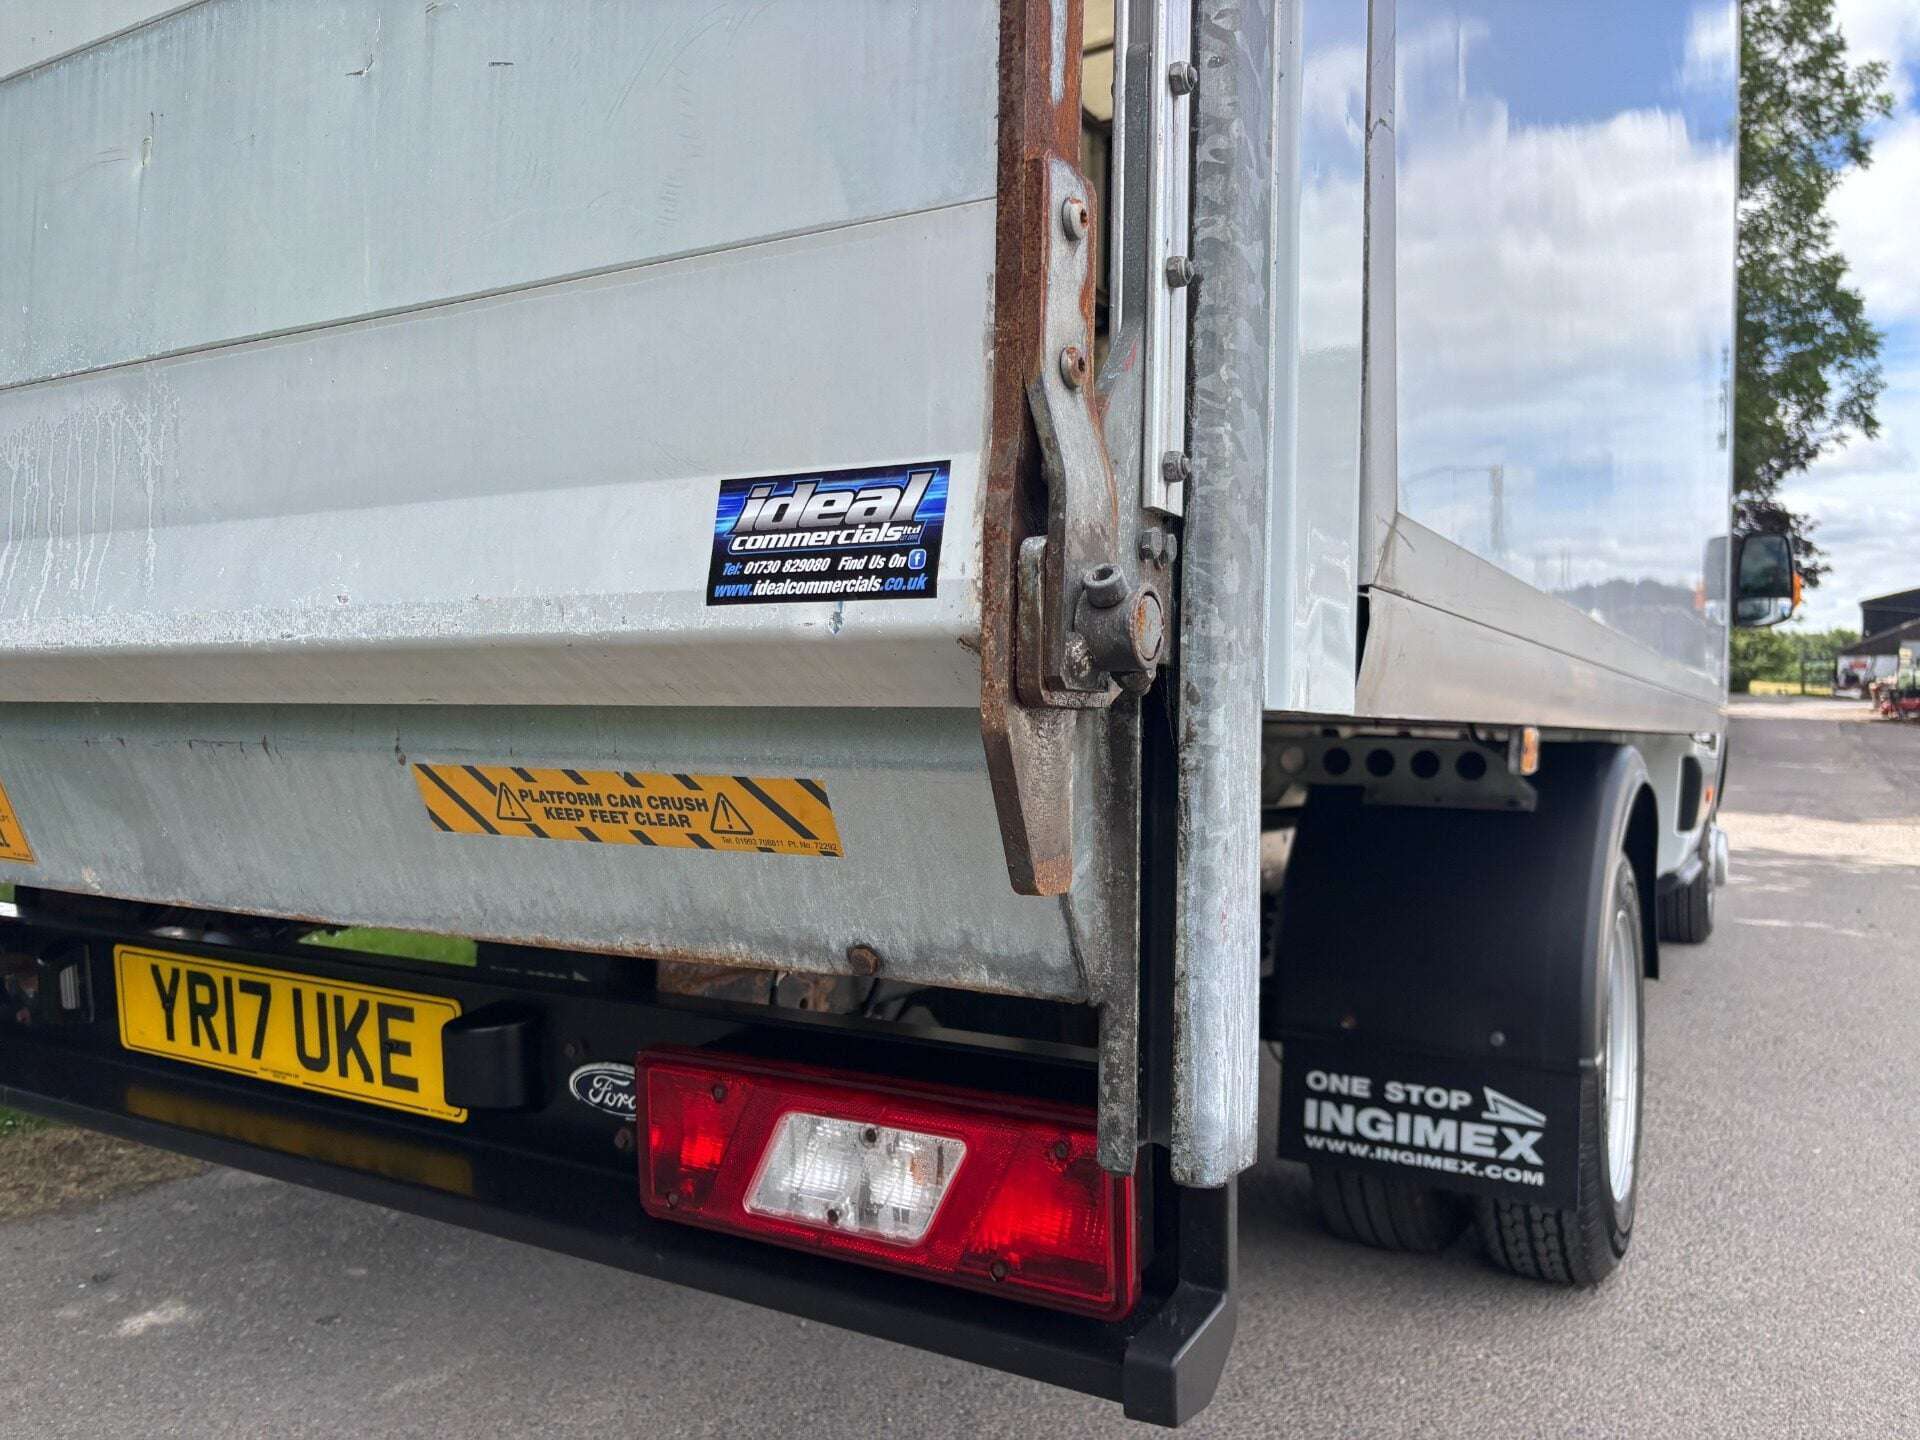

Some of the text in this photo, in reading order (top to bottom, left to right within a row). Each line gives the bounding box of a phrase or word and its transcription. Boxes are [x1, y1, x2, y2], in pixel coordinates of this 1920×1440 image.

[735, 472, 933, 533] ideal
[731, 523, 921, 551] commercials ltd
[722, 562, 742, 576] Tel:
[744, 560, 780, 575] 01730
[782, 558, 830, 573] 829080
[838, 556, 864, 571] Find
[869, 554, 885, 569] Us
[889, 554, 907, 568] On
[714, 573, 928, 598] www.idealcommercials.co.uk
[518, 788, 709, 812] PLATFORM CAN CRUSH
[544, 806, 692, 828] KEEP FEET CLEAR
[151, 964, 419, 1093] YR17 UKE
[1305, 1070, 1473, 1111] ONE STOP
[1303, 1098, 1545, 1166] INGIMEX
[1303, 1134, 1545, 1187] WWW.INGIMEX.COM
